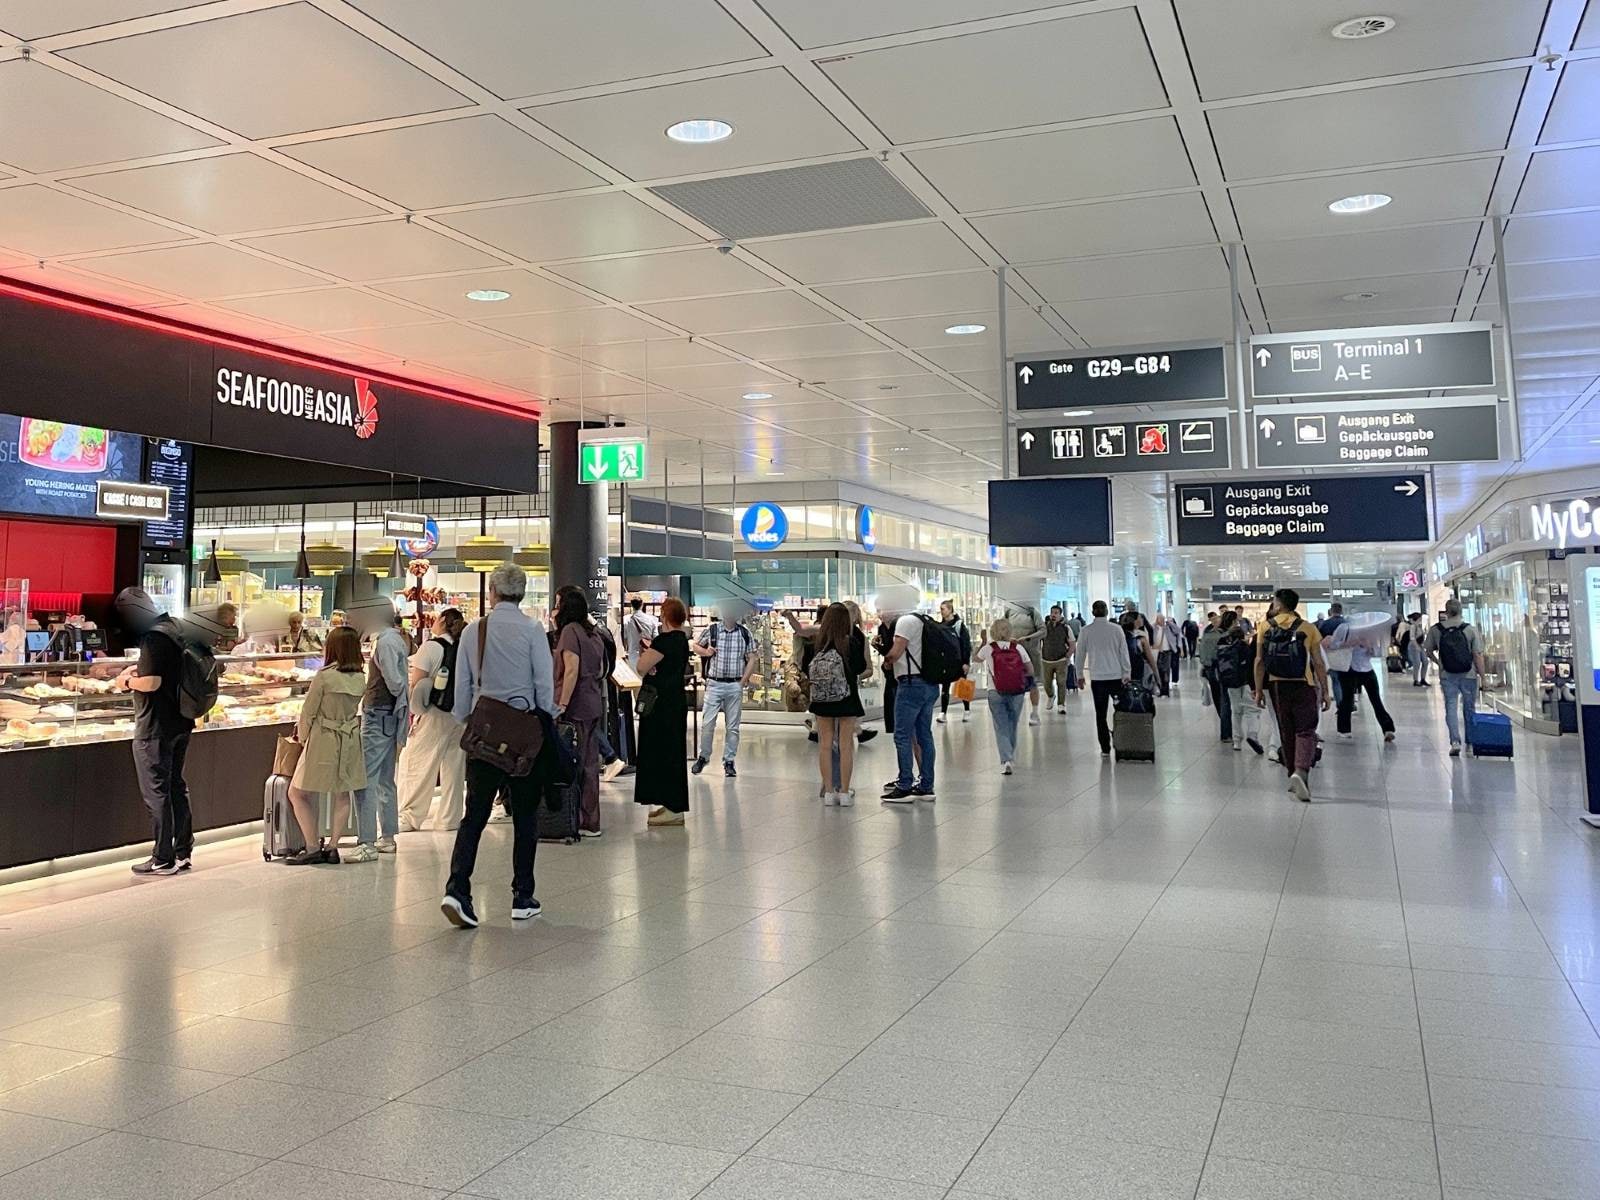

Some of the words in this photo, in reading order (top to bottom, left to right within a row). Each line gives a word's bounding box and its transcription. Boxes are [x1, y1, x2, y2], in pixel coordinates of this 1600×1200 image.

[1293, 349, 1319, 361] BUS
[1333, 338, 1409, 359] Terminal
[1414, 338, 1423, 354] 1
[1049, 363, 1073, 374] Gate
[217, 368, 304, 417] SEAFOOD
[304, 386, 314, 420] MEETS
[314, 390, 353, 427] ASIA
[1338, 415, 1389, 428] Ausgang
[1392, 412, 1415, 425] Exit
[1108, 427, 1123, 437] WC
[1339, 429, 1434, 445] Gepäckausgabe
[0, 440, 20, 463] SE
[1340, 447, 1392, 461] Baggage
[1394, 445, 1429, 458] Claim
[24, 478, 49, 488] YOUNG
[49, 481, 75, 491] HERING
[1225, 486, 1282, 500] Ausgang
[1286, 484, 1311, 497] Exit
[1225, 502, 1329, 518] Gepäckausgabe
[1225, 521, 1283, 537] Baggage
[1287, 519, 1325, 533] Claim
